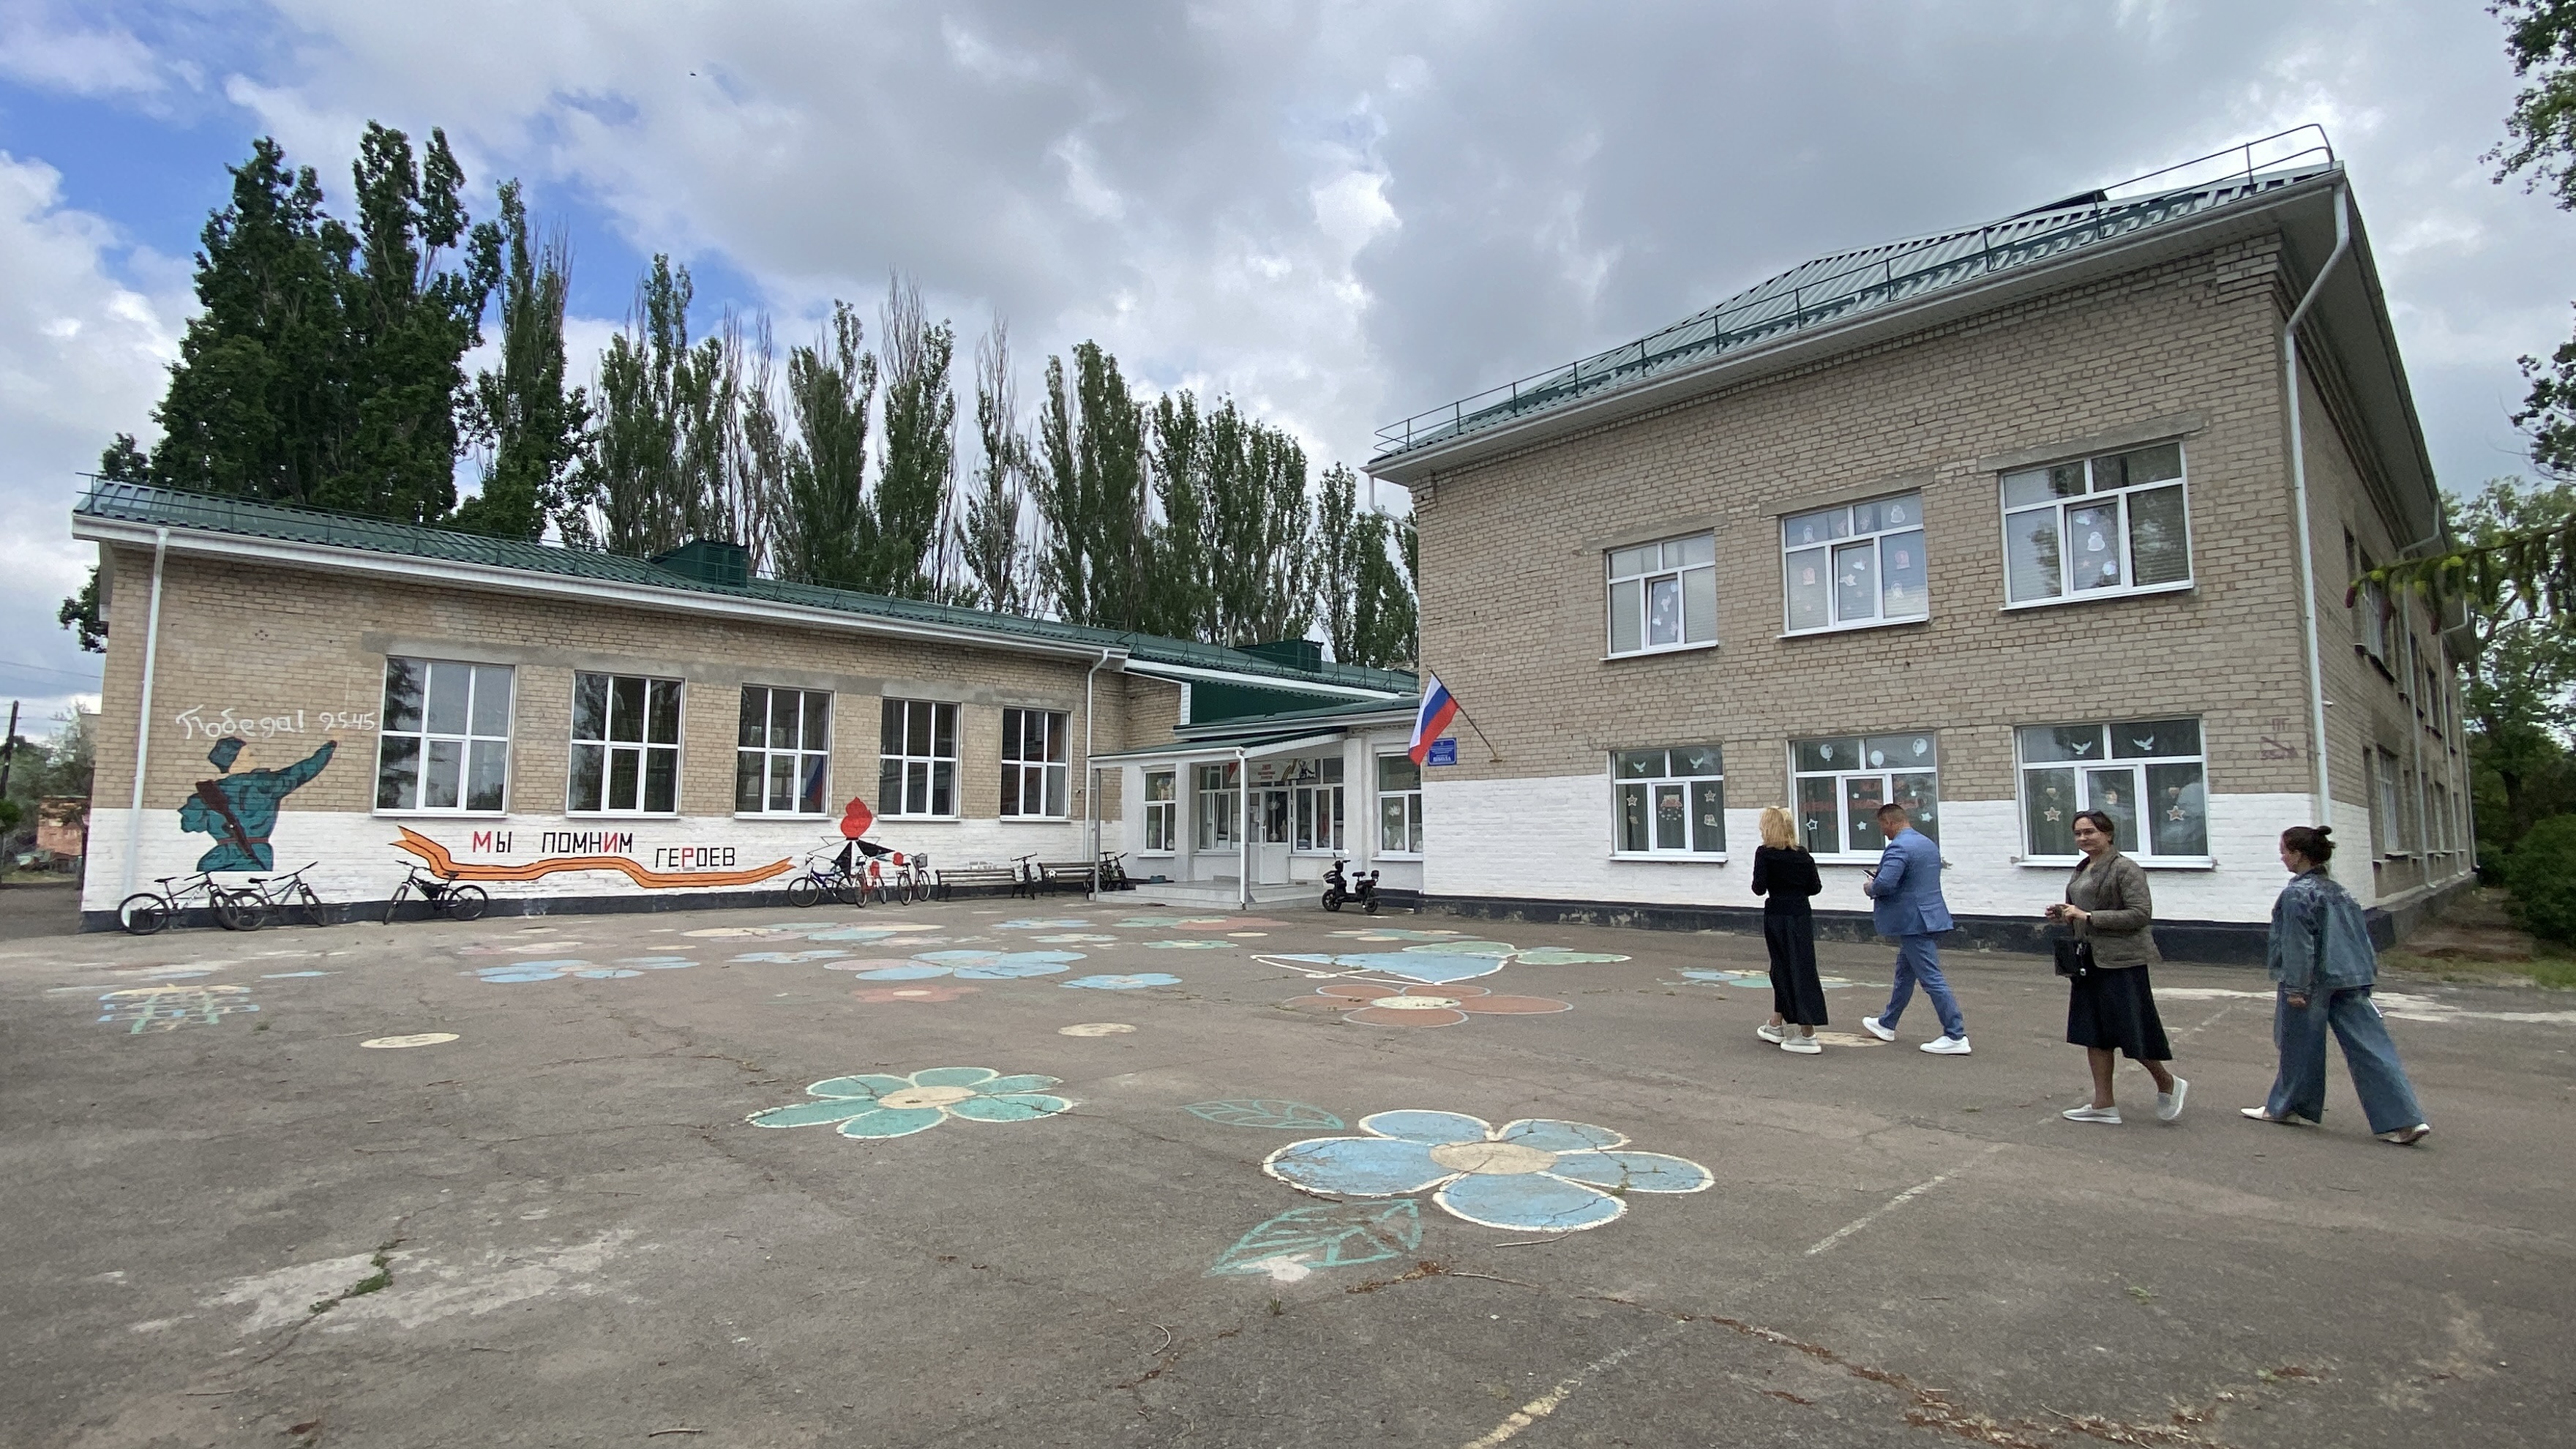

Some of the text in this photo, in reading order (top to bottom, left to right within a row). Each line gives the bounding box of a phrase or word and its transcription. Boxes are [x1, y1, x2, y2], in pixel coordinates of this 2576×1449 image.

[175, 703, 304, 739] Победа!
[542, 831, 633, 854] ПОМНИМ
[655, 847, 735, 868] ГЕРОЕВ
